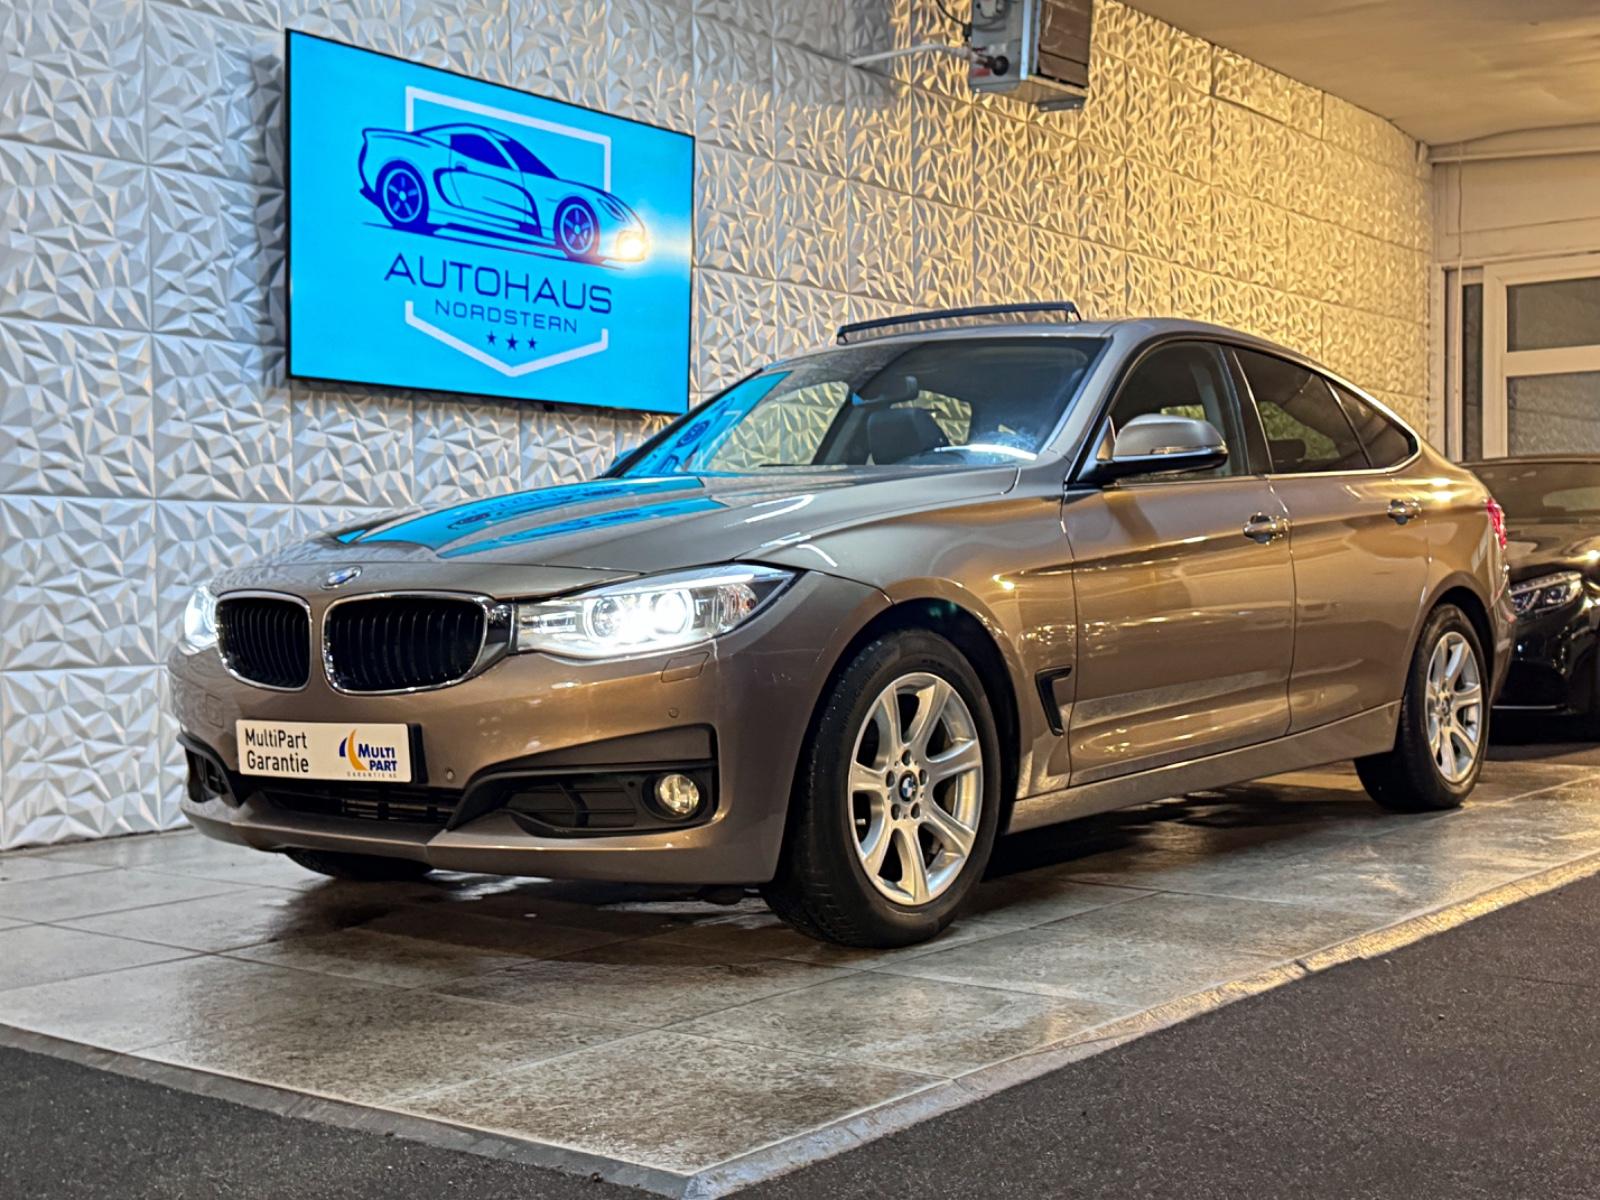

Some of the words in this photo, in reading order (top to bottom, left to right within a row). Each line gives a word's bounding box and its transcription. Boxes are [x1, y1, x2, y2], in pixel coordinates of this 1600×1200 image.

[384, 253, 612, 314] AUTOHAUS
[435, 299, 577, 333] NORDSTERN
[245, 728, 308, 749] MultiPart
[247, 750, 309, 773] Garantie
[369, 760, 397, 772] PART
